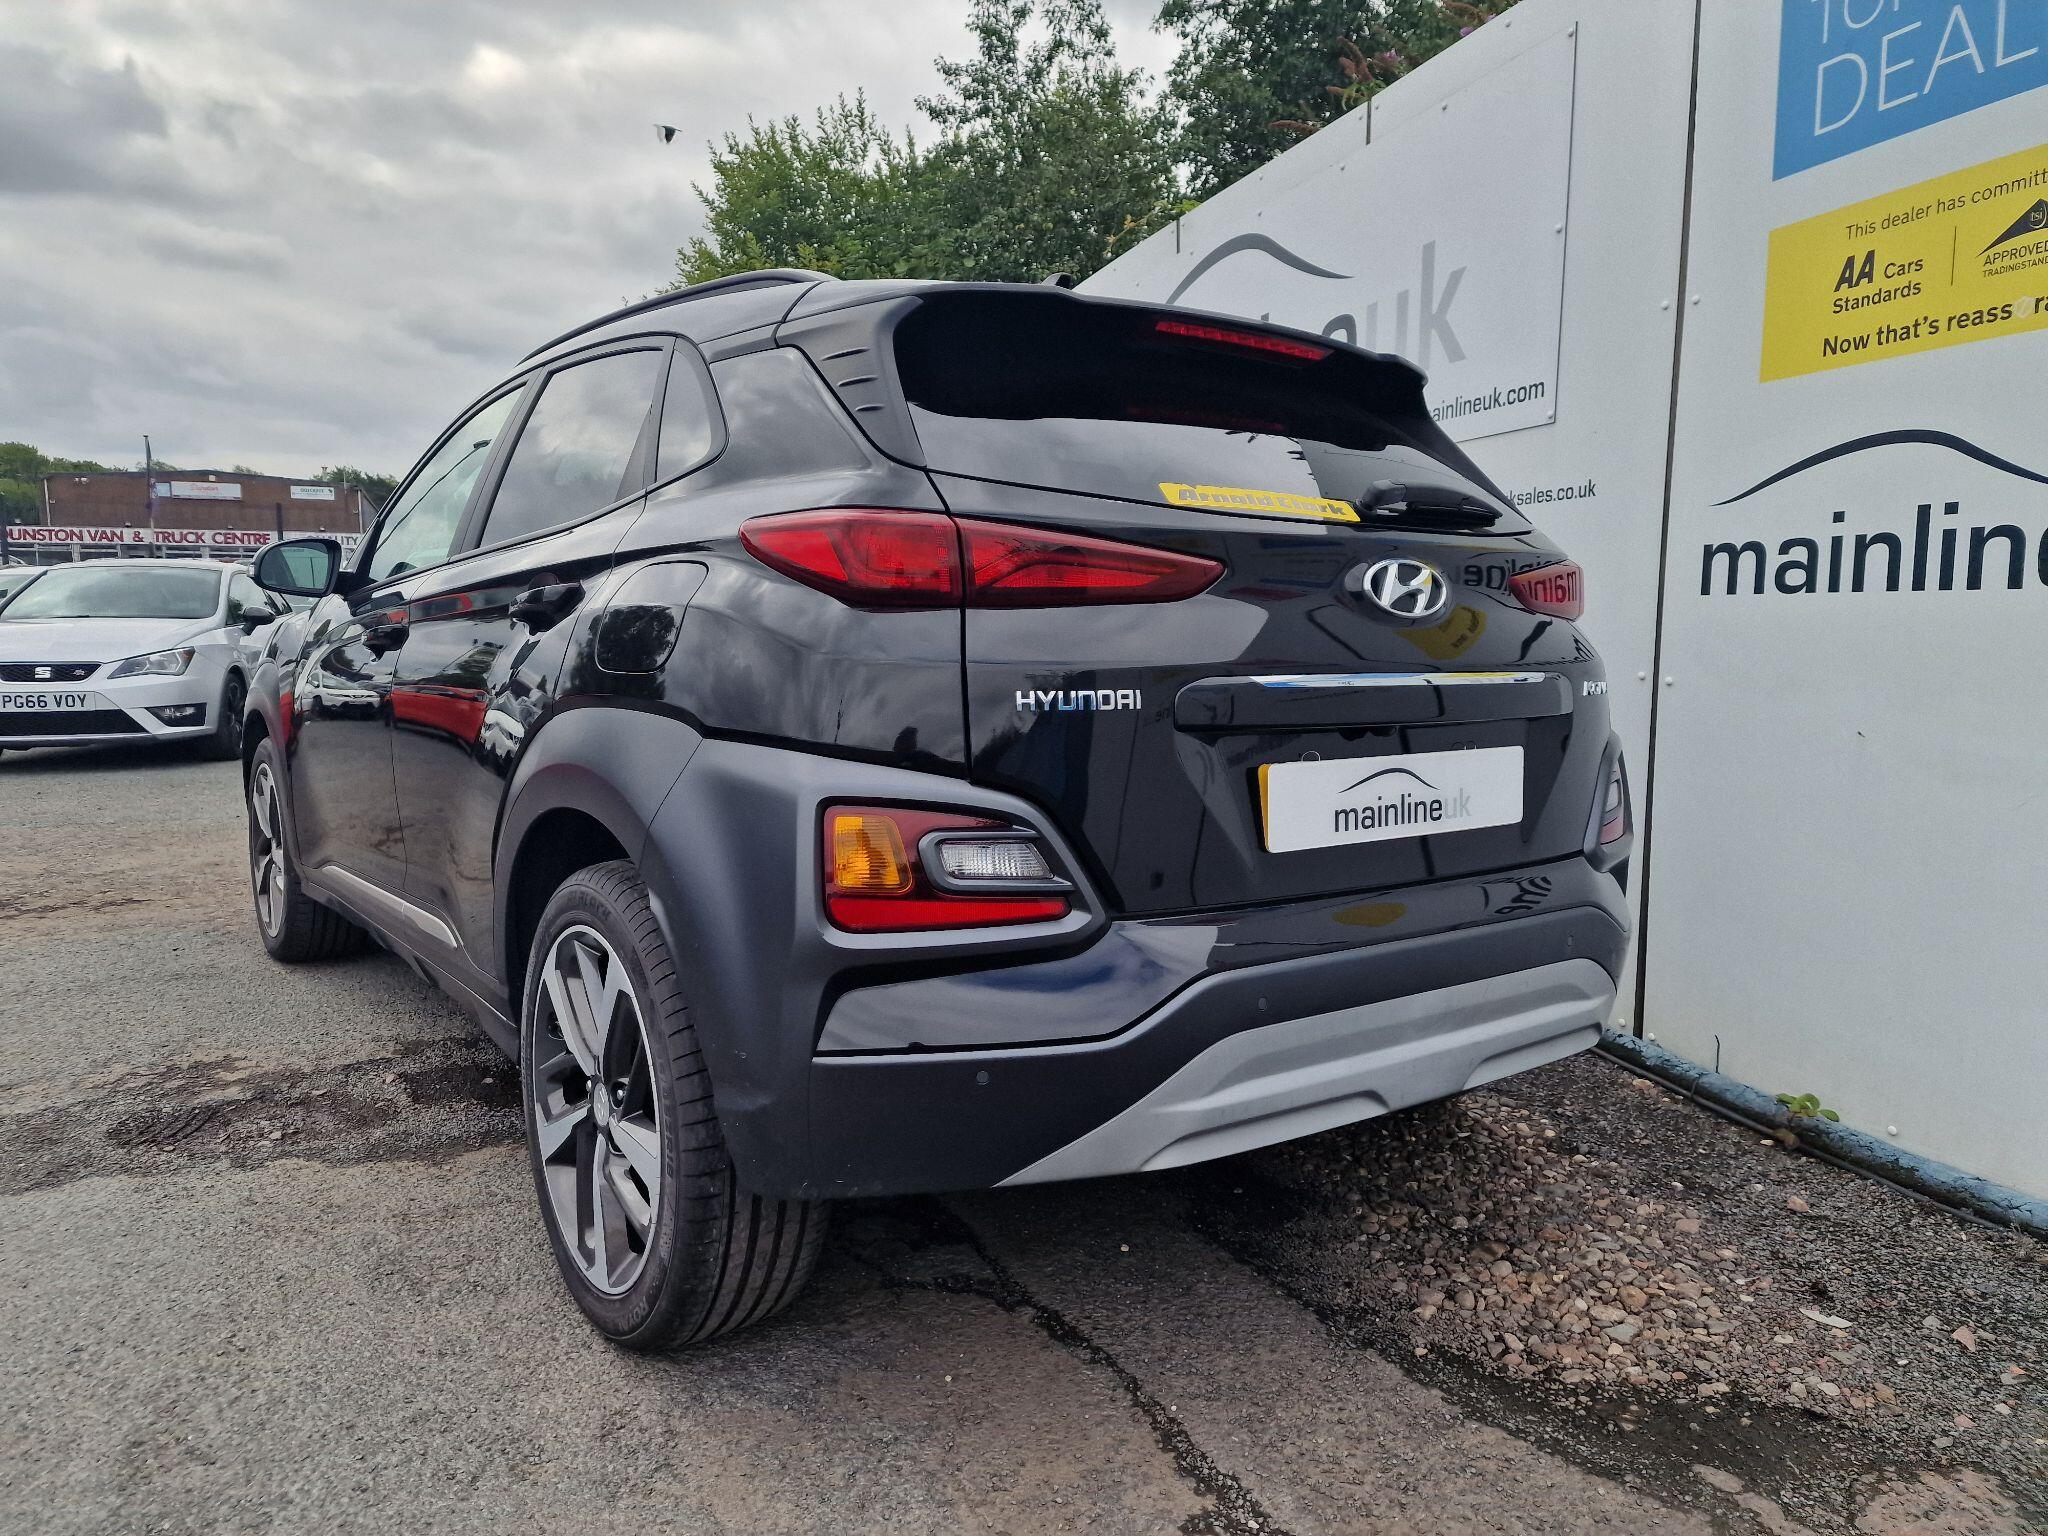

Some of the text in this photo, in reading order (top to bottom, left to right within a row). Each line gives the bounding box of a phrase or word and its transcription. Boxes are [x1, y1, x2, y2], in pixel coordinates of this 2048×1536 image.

[1846, 220, 1876, 240] This
[1881, 204, 1932, 230] dealer
[1936, 194, 1966, 214] has
[1834, 250, 1924, 293] AA Cars
[1832, 281, 1922, 314] Standards
[1823, 296, 2048, 357] Now that's reassr
[1429, 381, 1545, 422] ainlineuk.com
[1505, 479, 1597, 506] ksales.co.uk
[7, 528, 271, 545] UNSTON VAN & TRUCK CENTRE
[1700, 501, 2048, 596] mainlin
[2, 693, 87, 709] PG66 VOY
[1016, 689, 1142, 711] HYUNDAI
